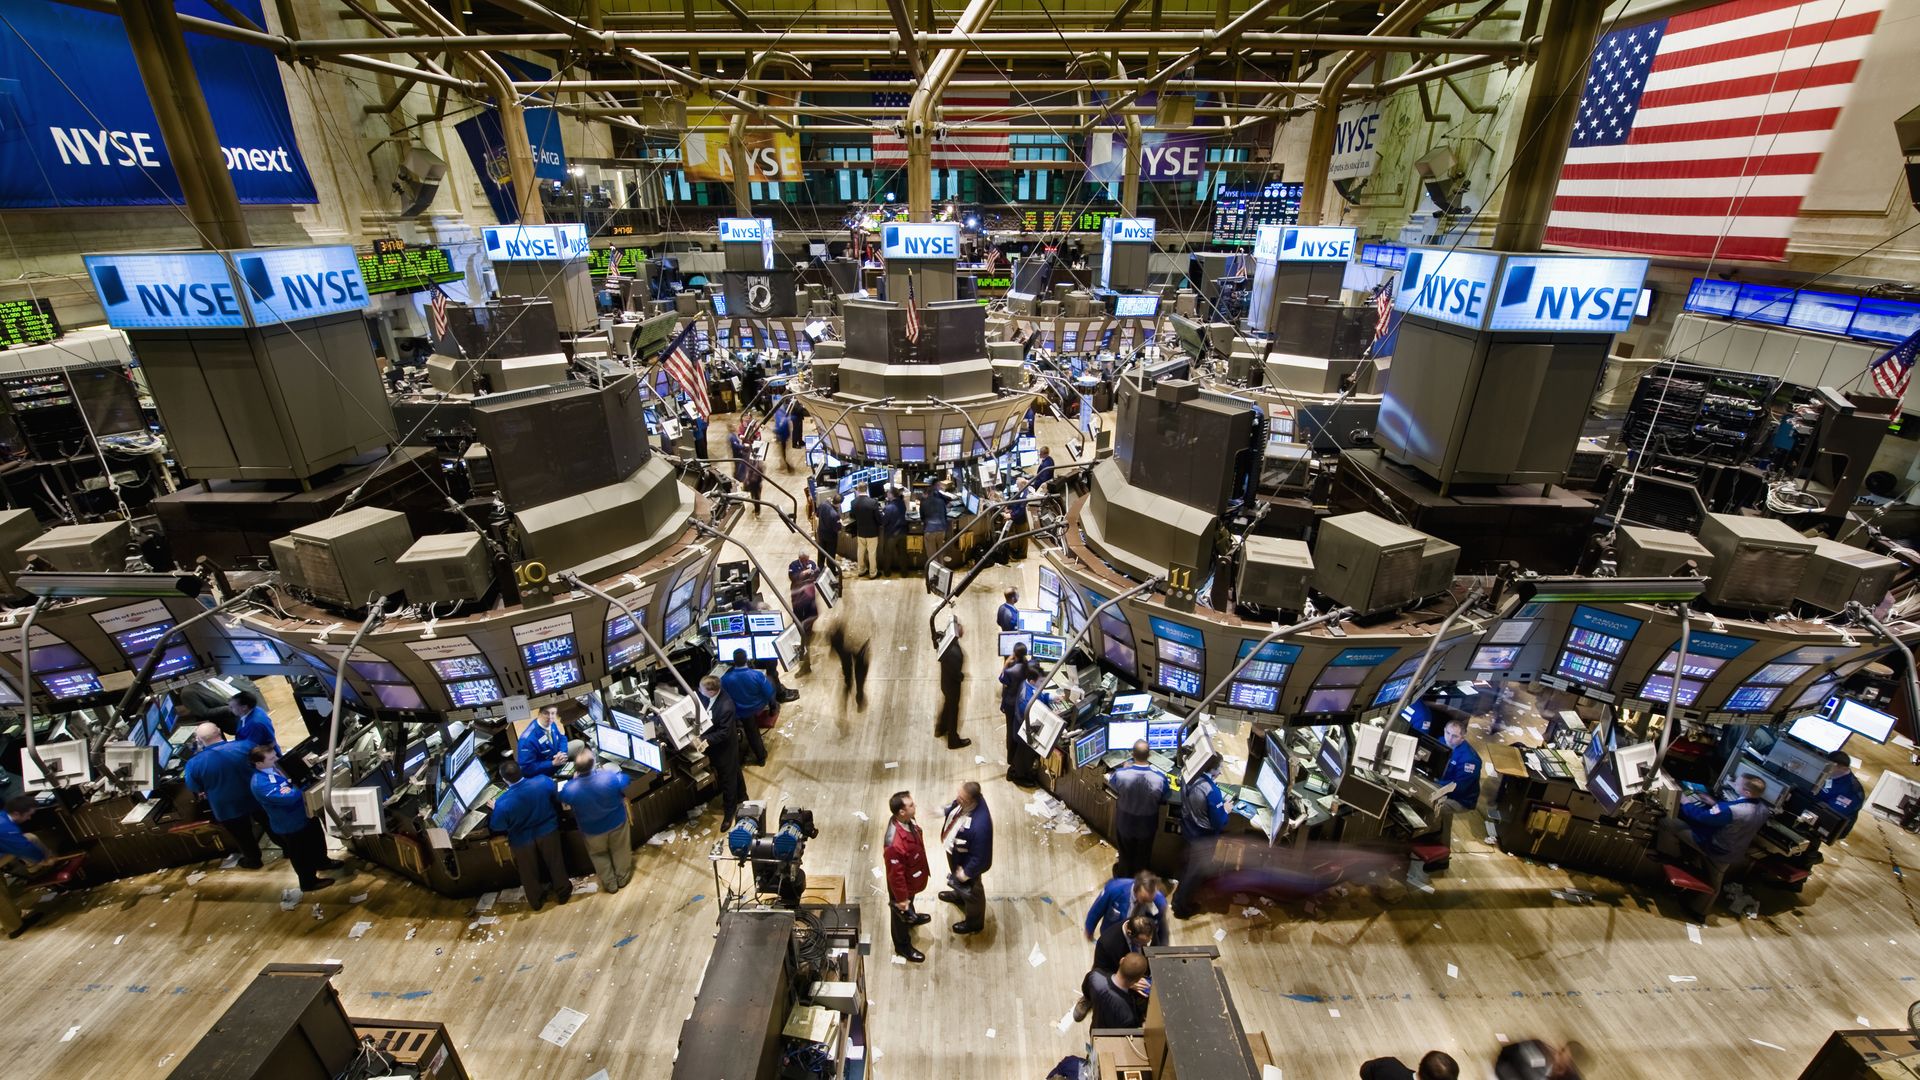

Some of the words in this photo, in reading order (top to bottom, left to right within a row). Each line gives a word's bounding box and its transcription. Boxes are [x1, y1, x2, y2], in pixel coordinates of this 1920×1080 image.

[1332, 113, 1380, 156] NYSE
[49, 126, 161, 167] NYSE
[541, 148, 560, 165] Arca
[732, 228, 761, 239] NYSE
[1124, 227, 1152, 238] NYSE
[505, 239, 557, 257] NYSE
[569, 237, 589, 253] NYSE
[905, 237, 954, 254] NYSE
[1301, 240, 1351, 257] NYSE
[281, 269, 366, 311] NYSE
[1419, 274, 1486, 319] NYSE
[136, 283, 243, 317] NYSE
[1535, 286, 1638, 321] NYSE
[514, 562, 547, 587] 10
[1170, 568, 1191, 591] 11
[98, 616, 120, 624] Bank
[131, 606, 164, 617] America
[515, 628, 534, 636] Bank
[543, 621, 572, 630] America
